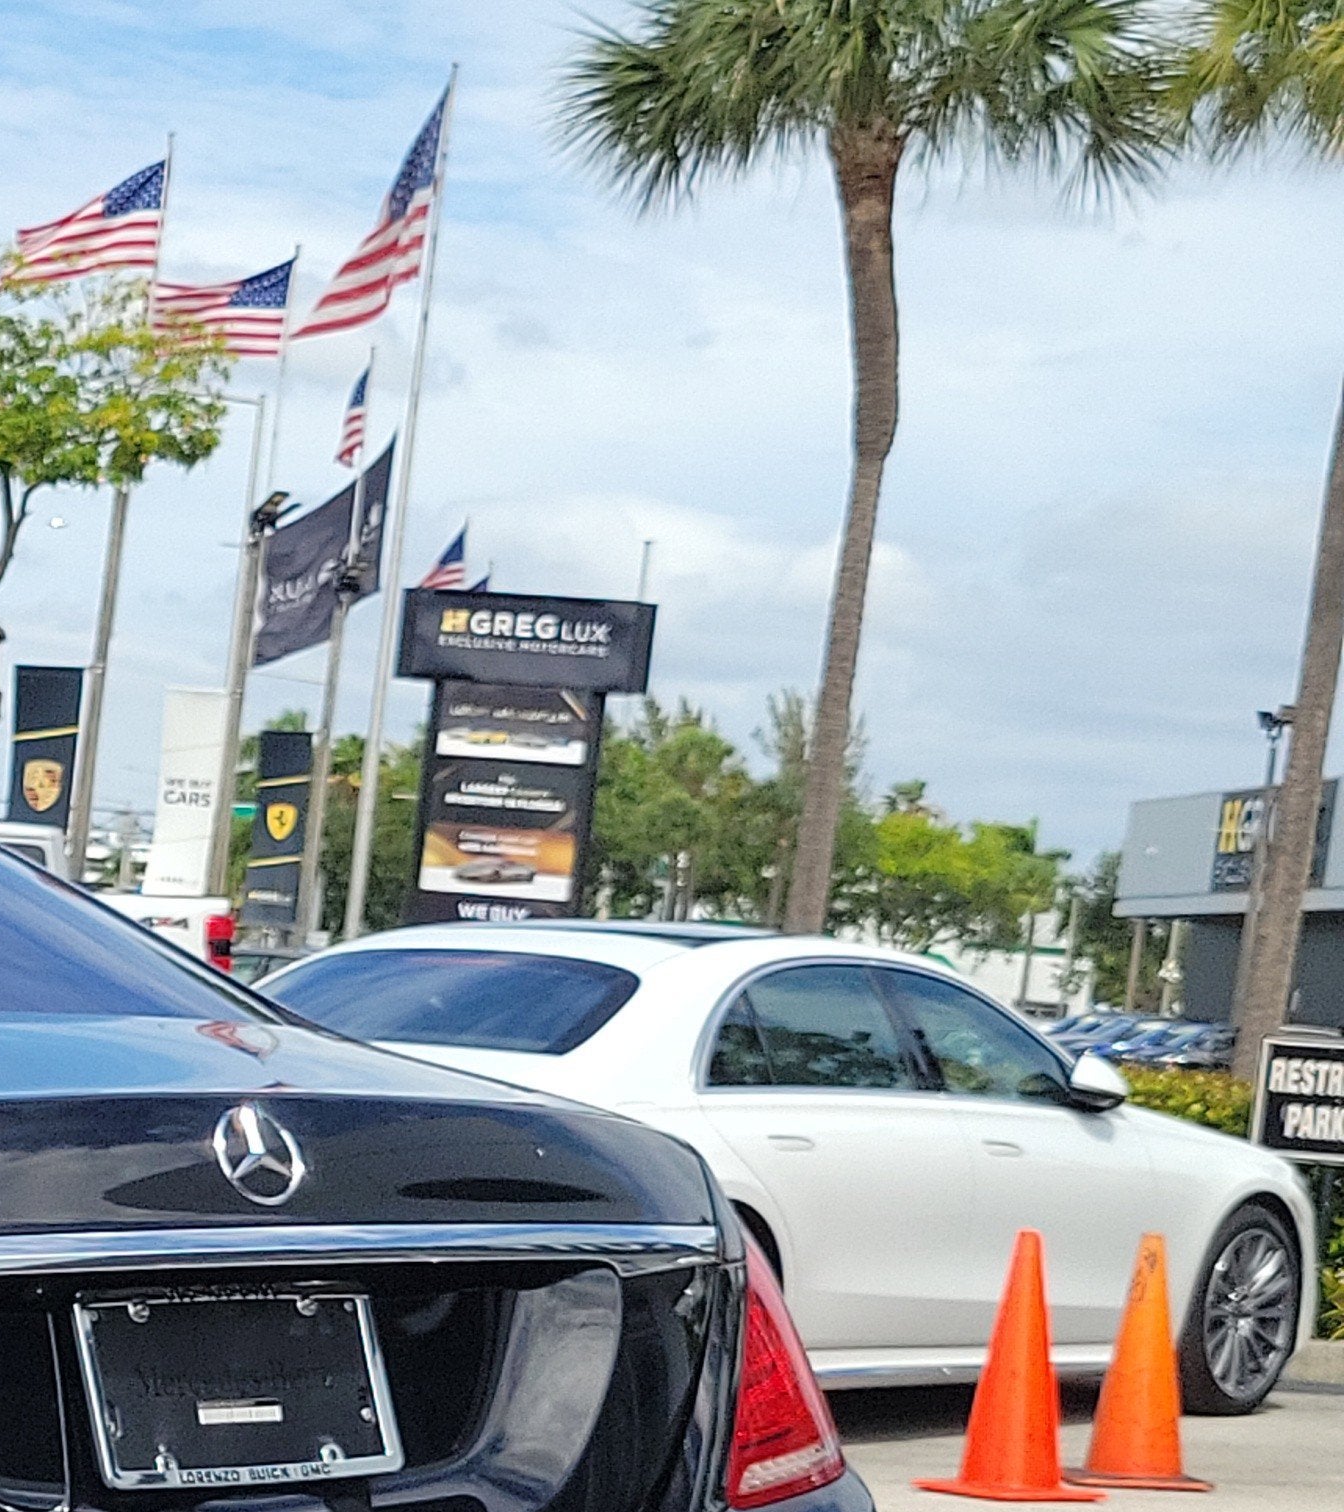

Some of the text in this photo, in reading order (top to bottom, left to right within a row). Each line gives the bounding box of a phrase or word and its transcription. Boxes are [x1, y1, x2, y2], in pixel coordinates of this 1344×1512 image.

[561, 620, 611, 643] LUX
[163, 789, 211, 808] CARS
[179, 1469, 241, 1485] LORENZO
[249, 1466, 290, 1481] BUICK
